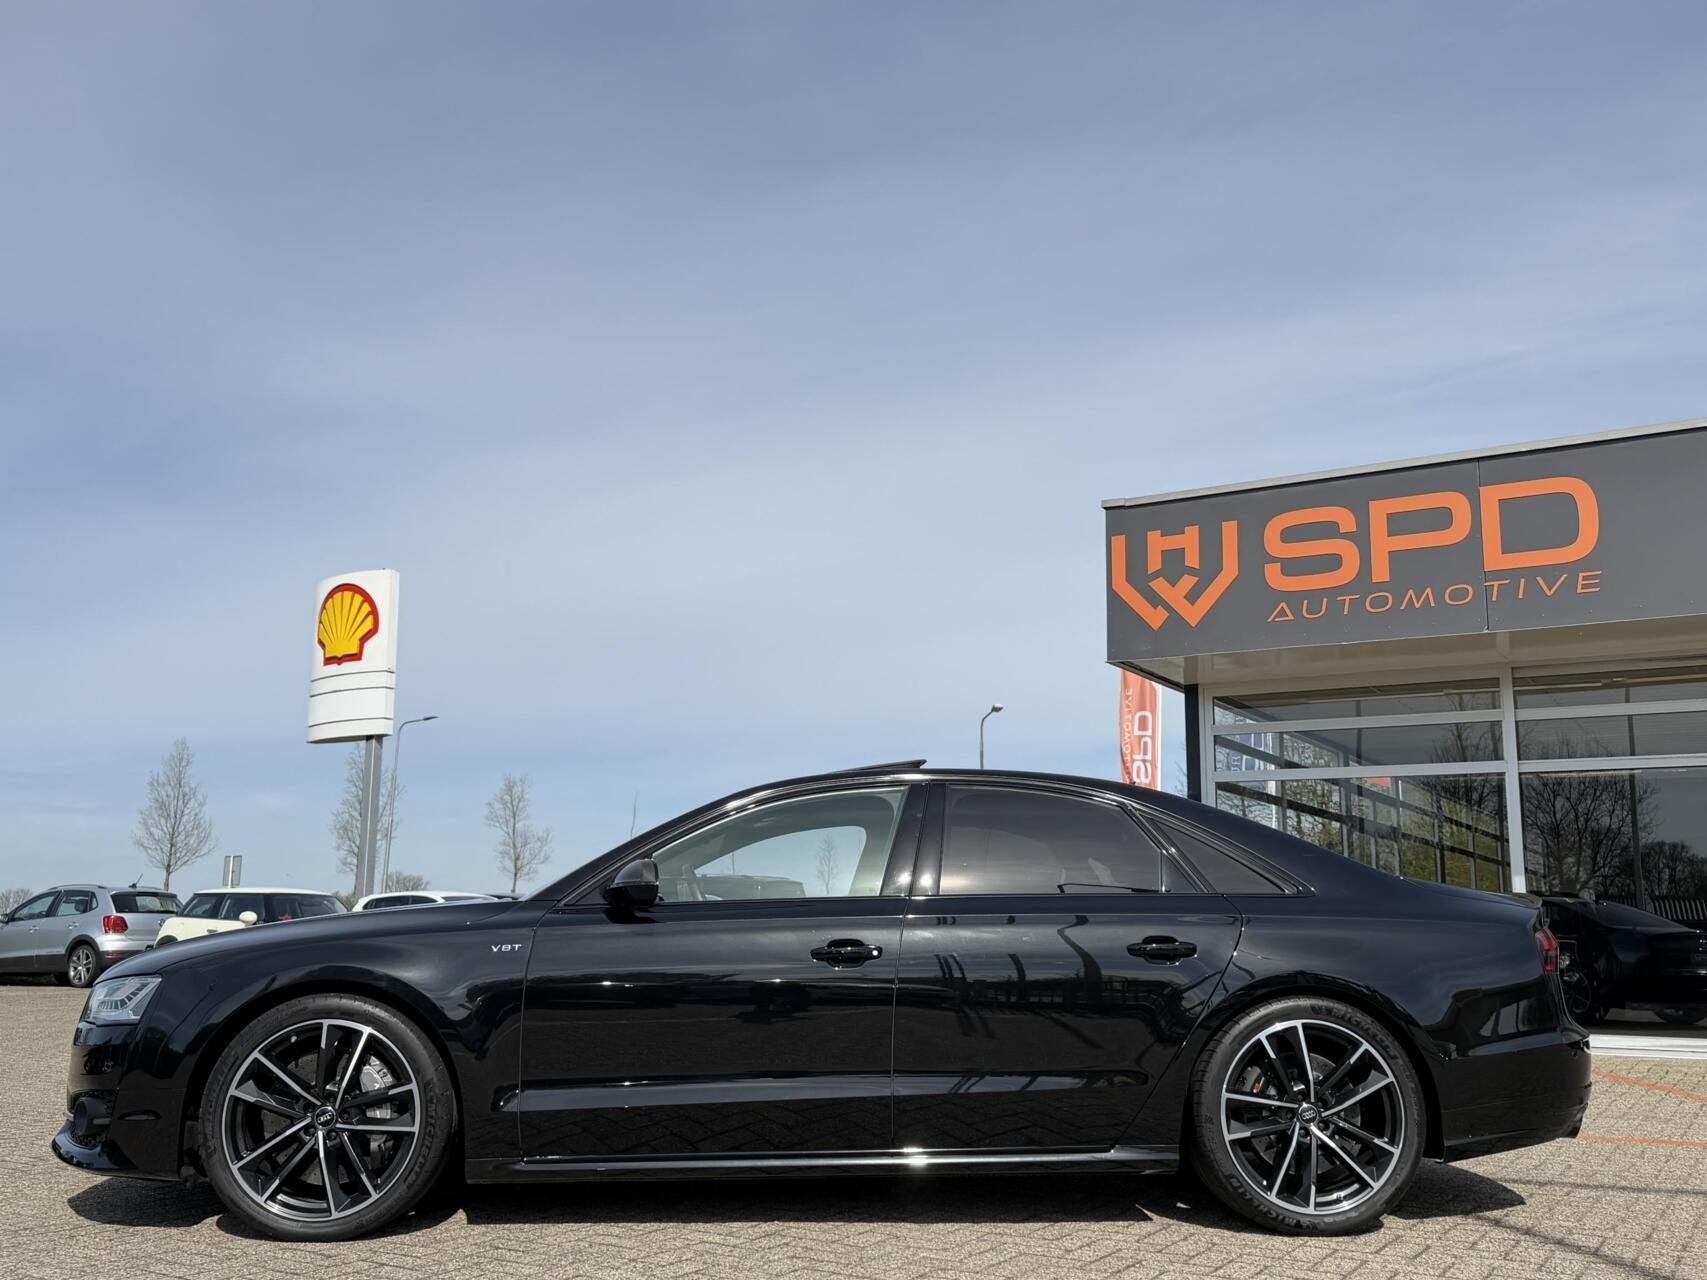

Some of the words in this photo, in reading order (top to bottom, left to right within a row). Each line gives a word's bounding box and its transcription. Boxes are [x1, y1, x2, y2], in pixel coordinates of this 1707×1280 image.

[1263, 476, 1600, 592] SPD
[1266, 569, 1603, 622] AUTOMOTIVE
[491, 944, 522, 952] V8T
